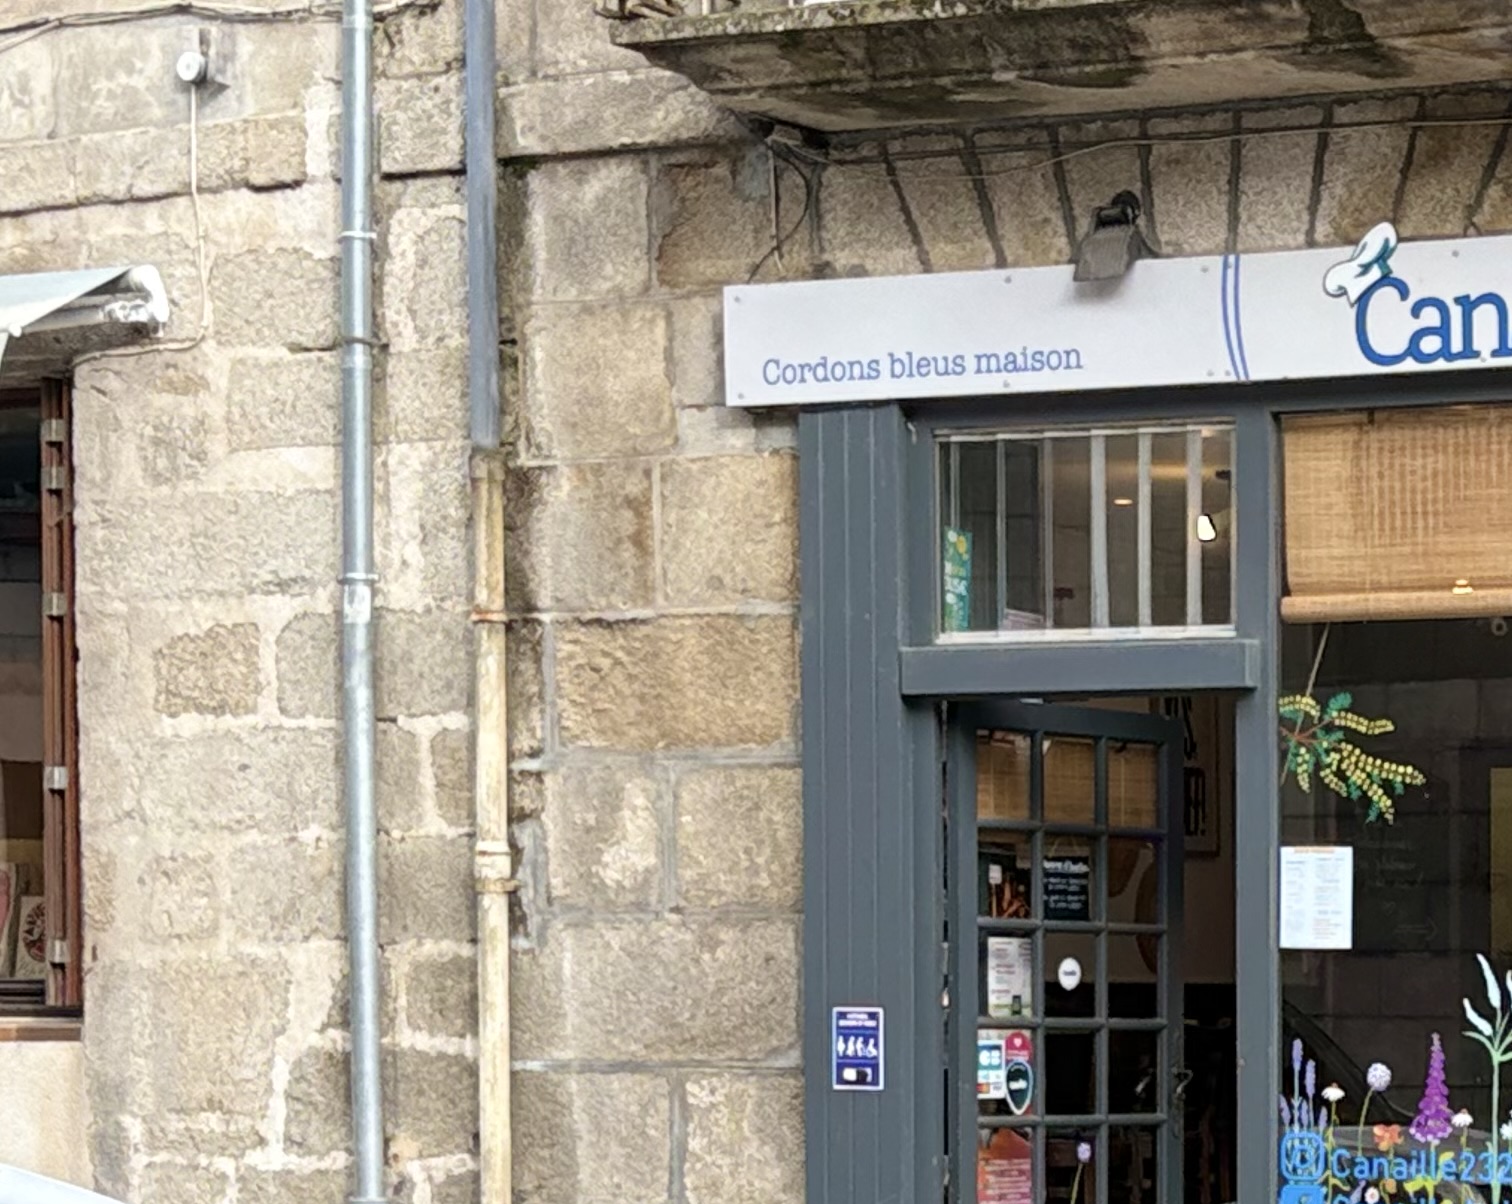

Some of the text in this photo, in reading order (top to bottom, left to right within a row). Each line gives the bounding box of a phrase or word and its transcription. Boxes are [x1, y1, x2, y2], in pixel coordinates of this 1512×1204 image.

[762, 346, 1084, 386] Cordons bleus maison
